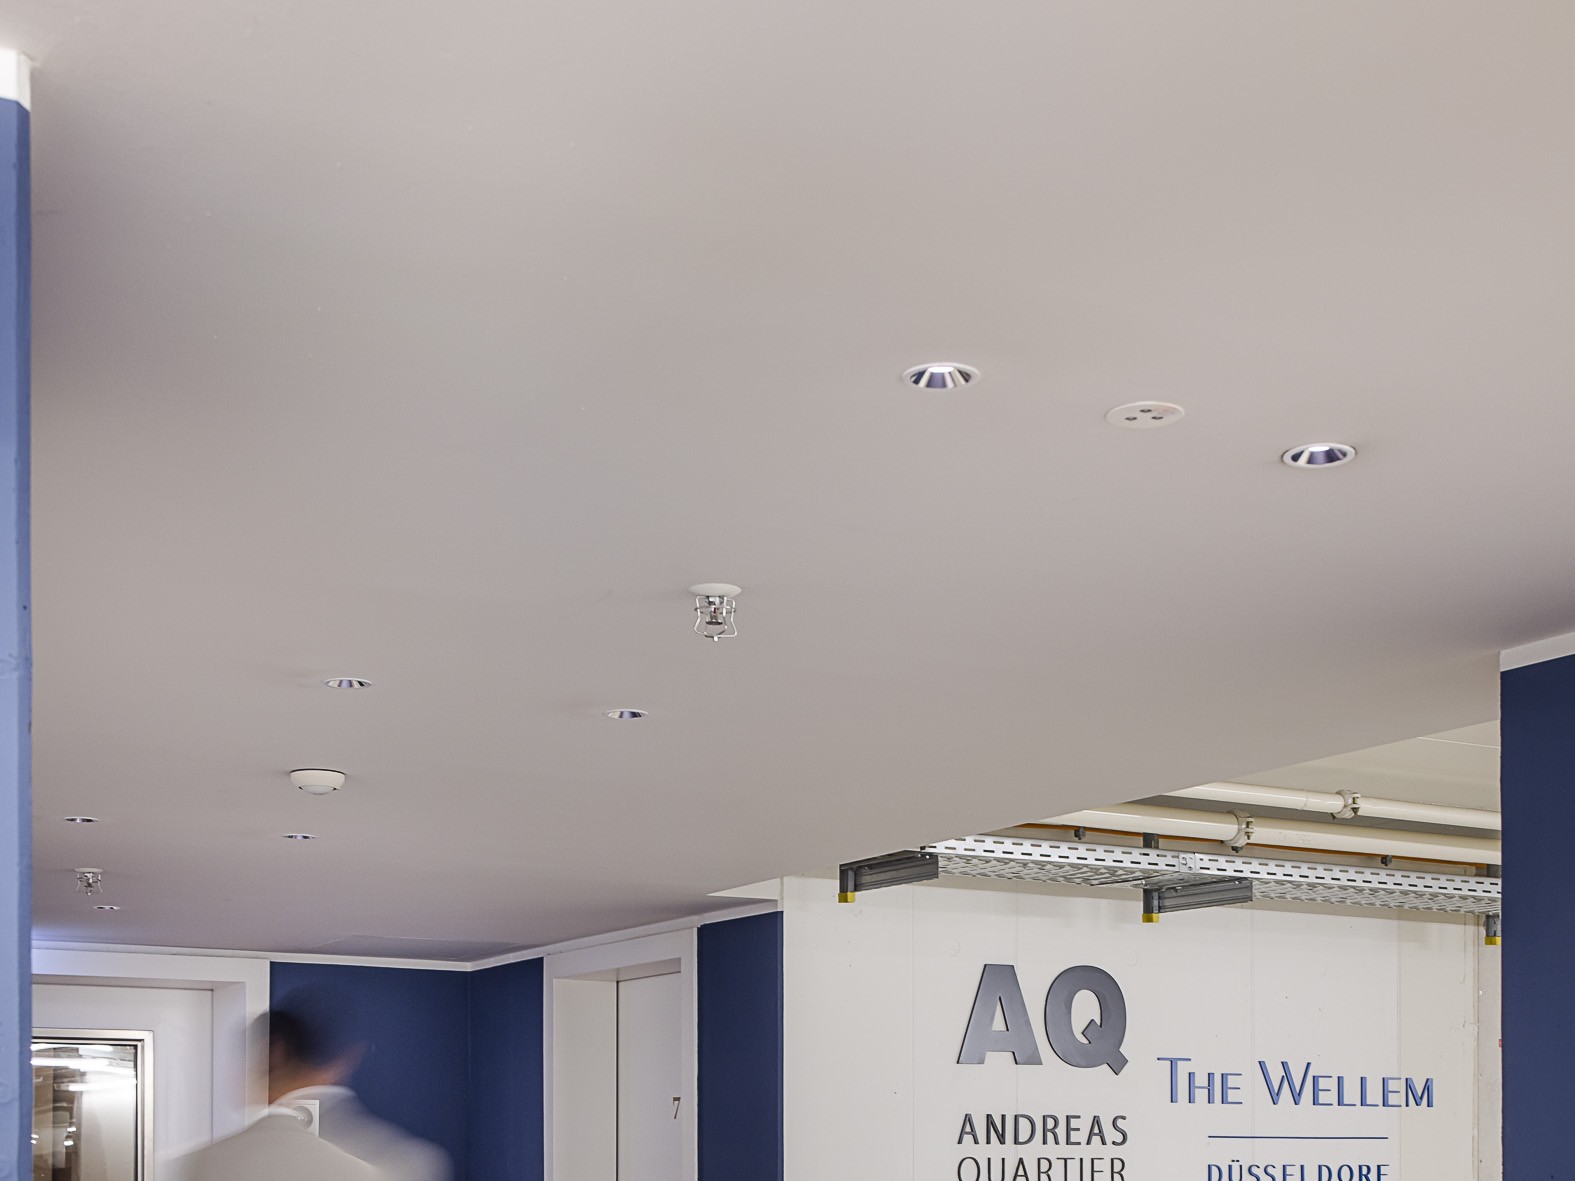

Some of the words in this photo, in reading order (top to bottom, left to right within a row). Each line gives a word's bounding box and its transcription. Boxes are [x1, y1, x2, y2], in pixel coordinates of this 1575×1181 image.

[956, 964, 1129, 1075] AQ
[672, 1096, 681, 1120] 7
[957, 1113, 1128, 1146] ANDREAS
